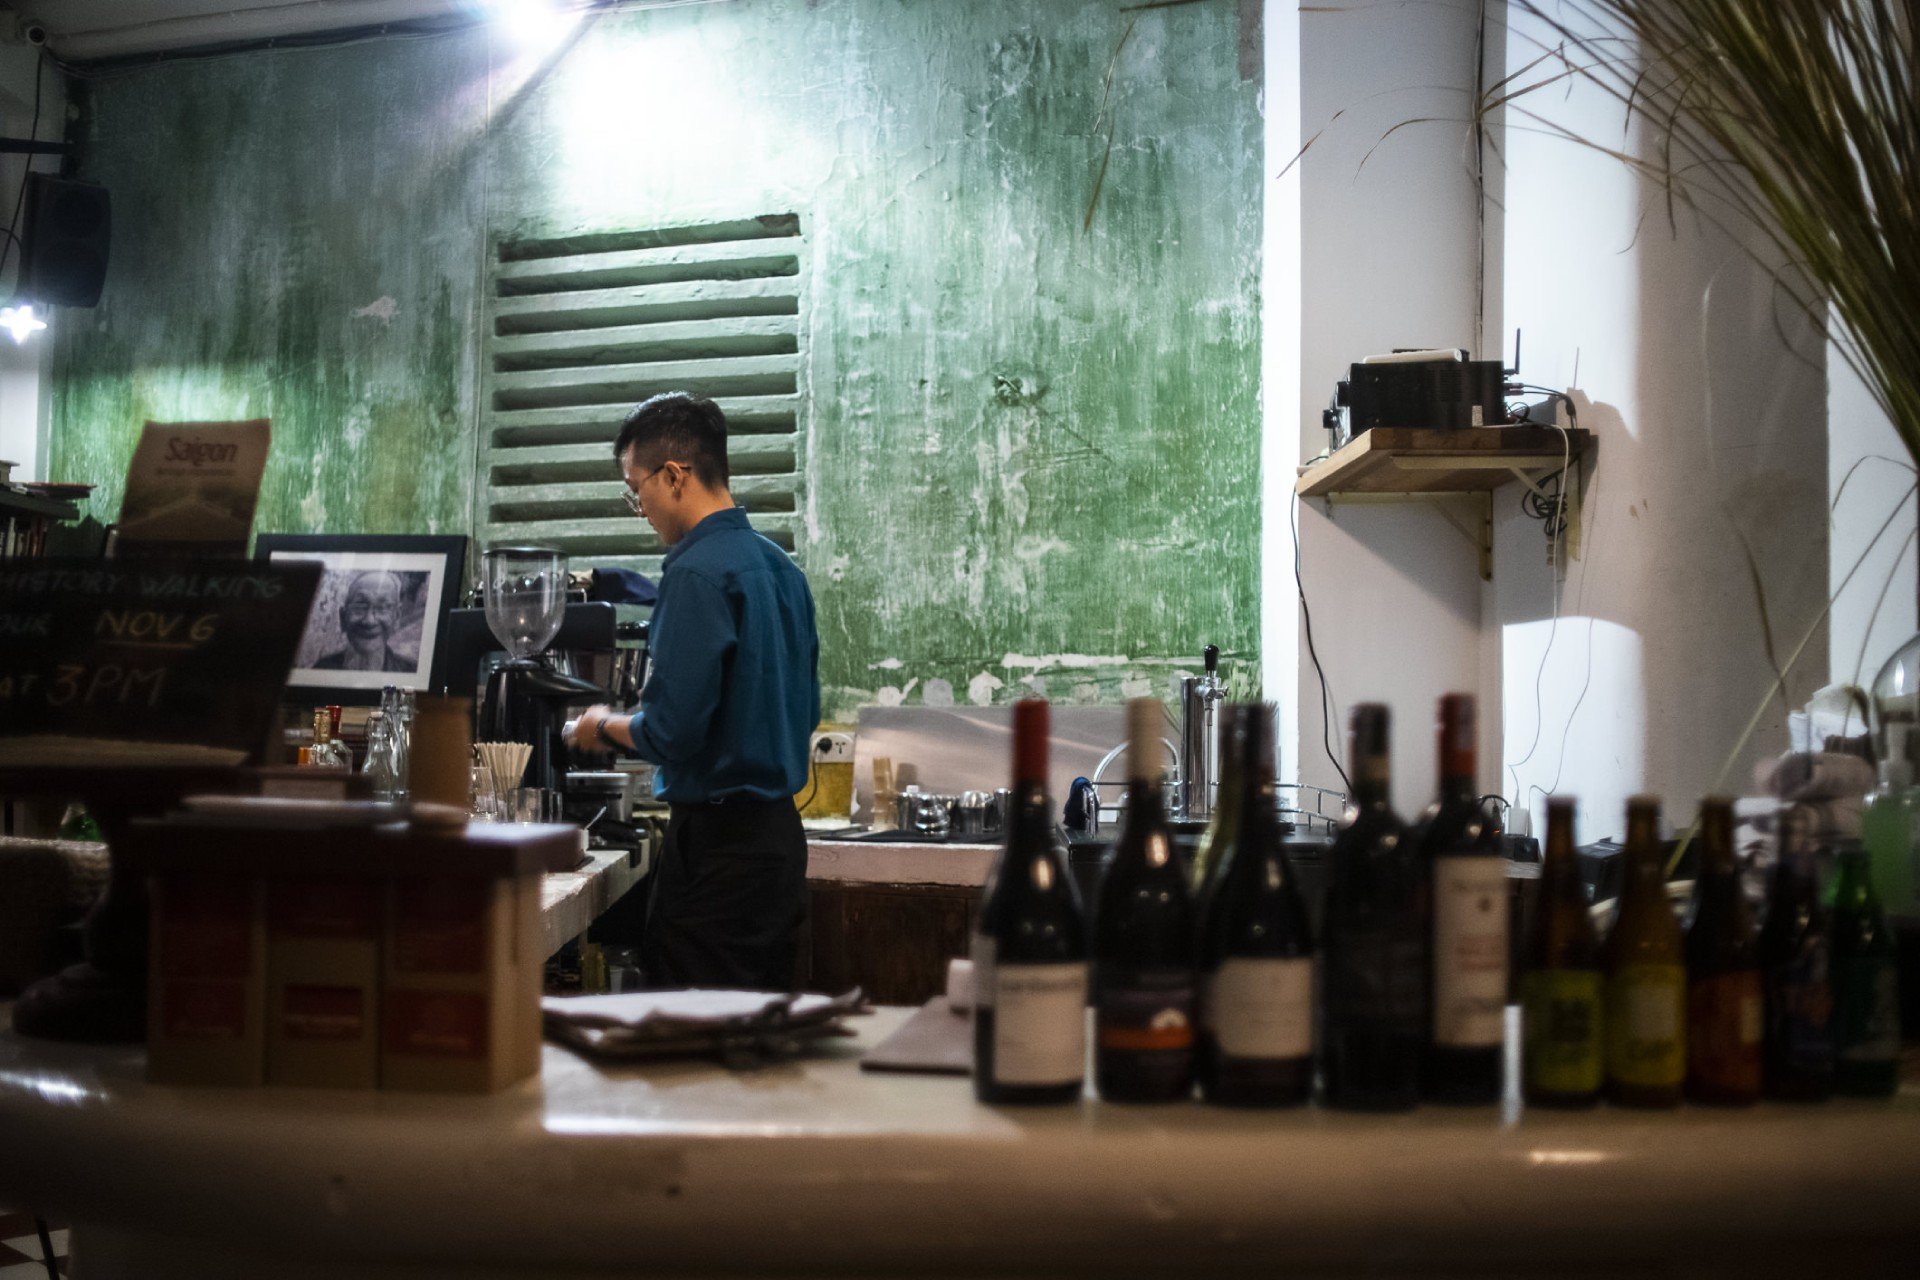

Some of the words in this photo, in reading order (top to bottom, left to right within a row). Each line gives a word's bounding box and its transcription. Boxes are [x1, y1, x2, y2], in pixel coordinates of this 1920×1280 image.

[164, 436, 238, 466] Saigon
[140, 573, 284, 599] WALKING
[95, 611, 184, 637] NOV
[189, 612, 219, 642] 6
